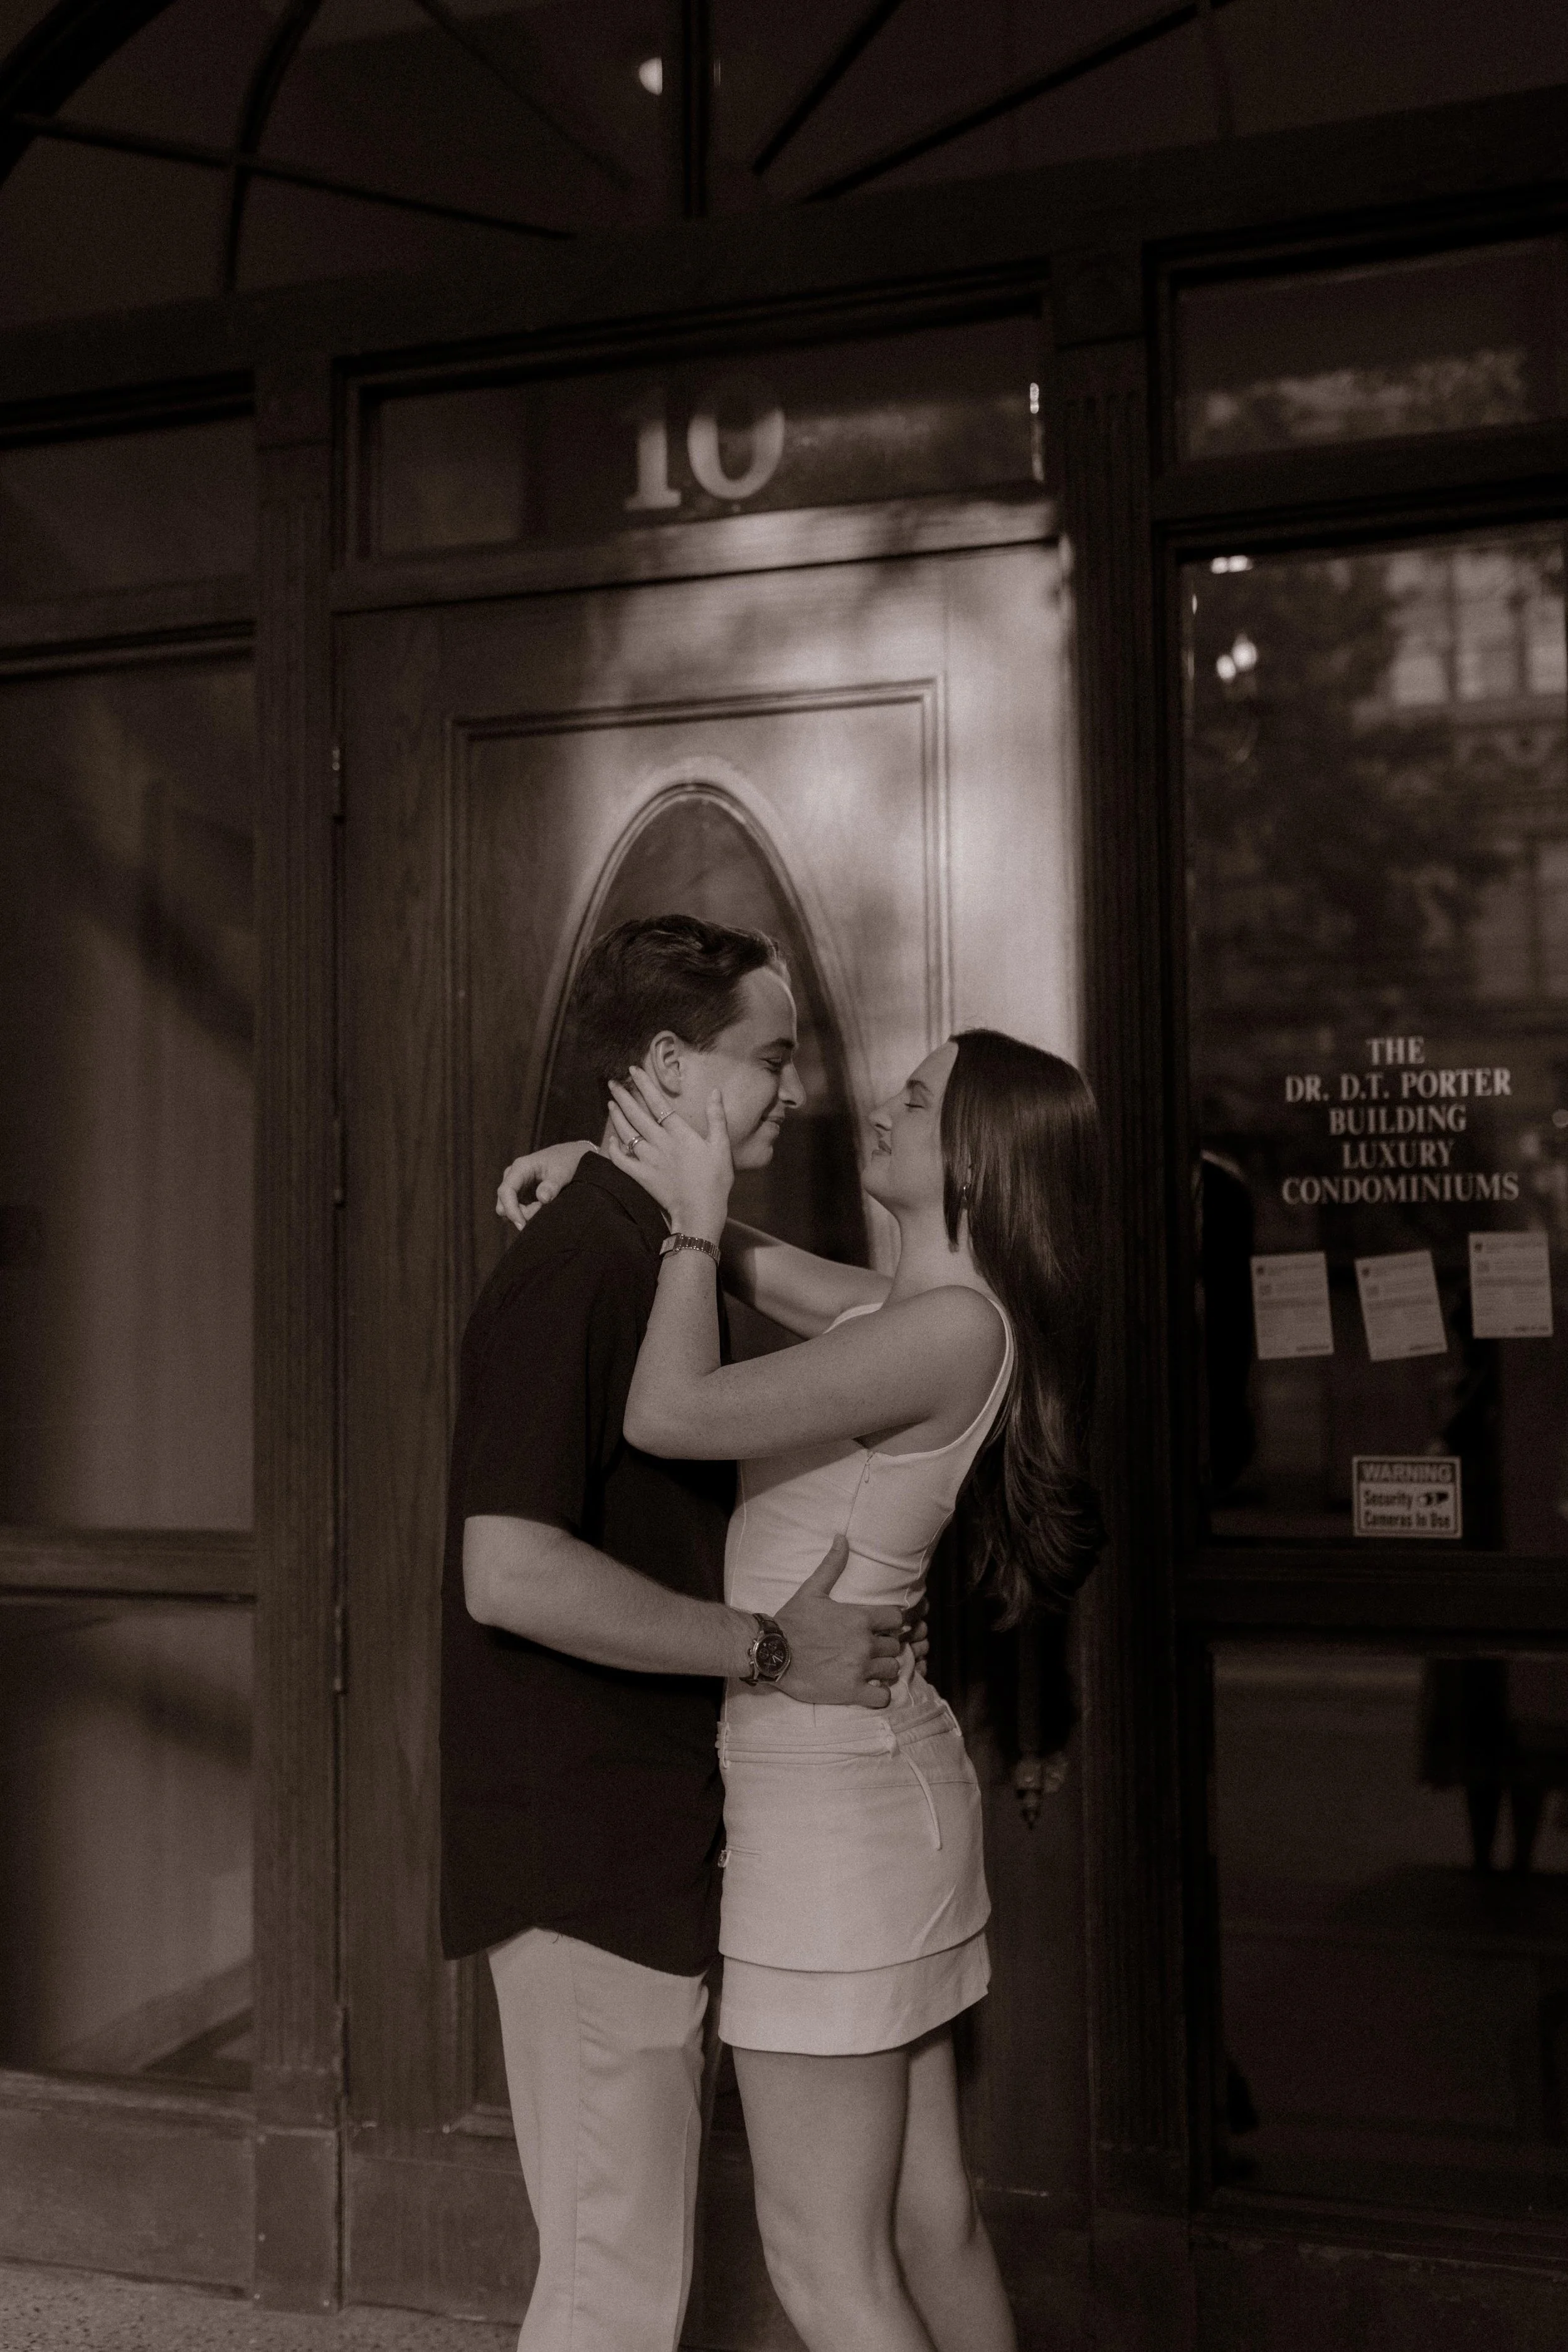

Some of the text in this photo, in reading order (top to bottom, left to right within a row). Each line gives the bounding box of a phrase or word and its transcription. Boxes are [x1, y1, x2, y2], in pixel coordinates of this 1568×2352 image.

[621, 373, 786, 511] 10
[1366, 1036, 1425, 1066] THE
[1285, 1068, 1512, 1103] DR. D.T. PORTER
[1328, 1104, 1466, 1136] BUILDING
[1342, 1140, 1455, 1170] LUXURY
[1282, 1173, 1520, 1205] CONDOMINIUMS
[1362, 1463, 1452, 1481] WARNING
[1365, 1490, 1412, 1509] Security
[1365, 1512, 1412, 1527] Cameras
[1431, 1512, 1450, 1527] Use
